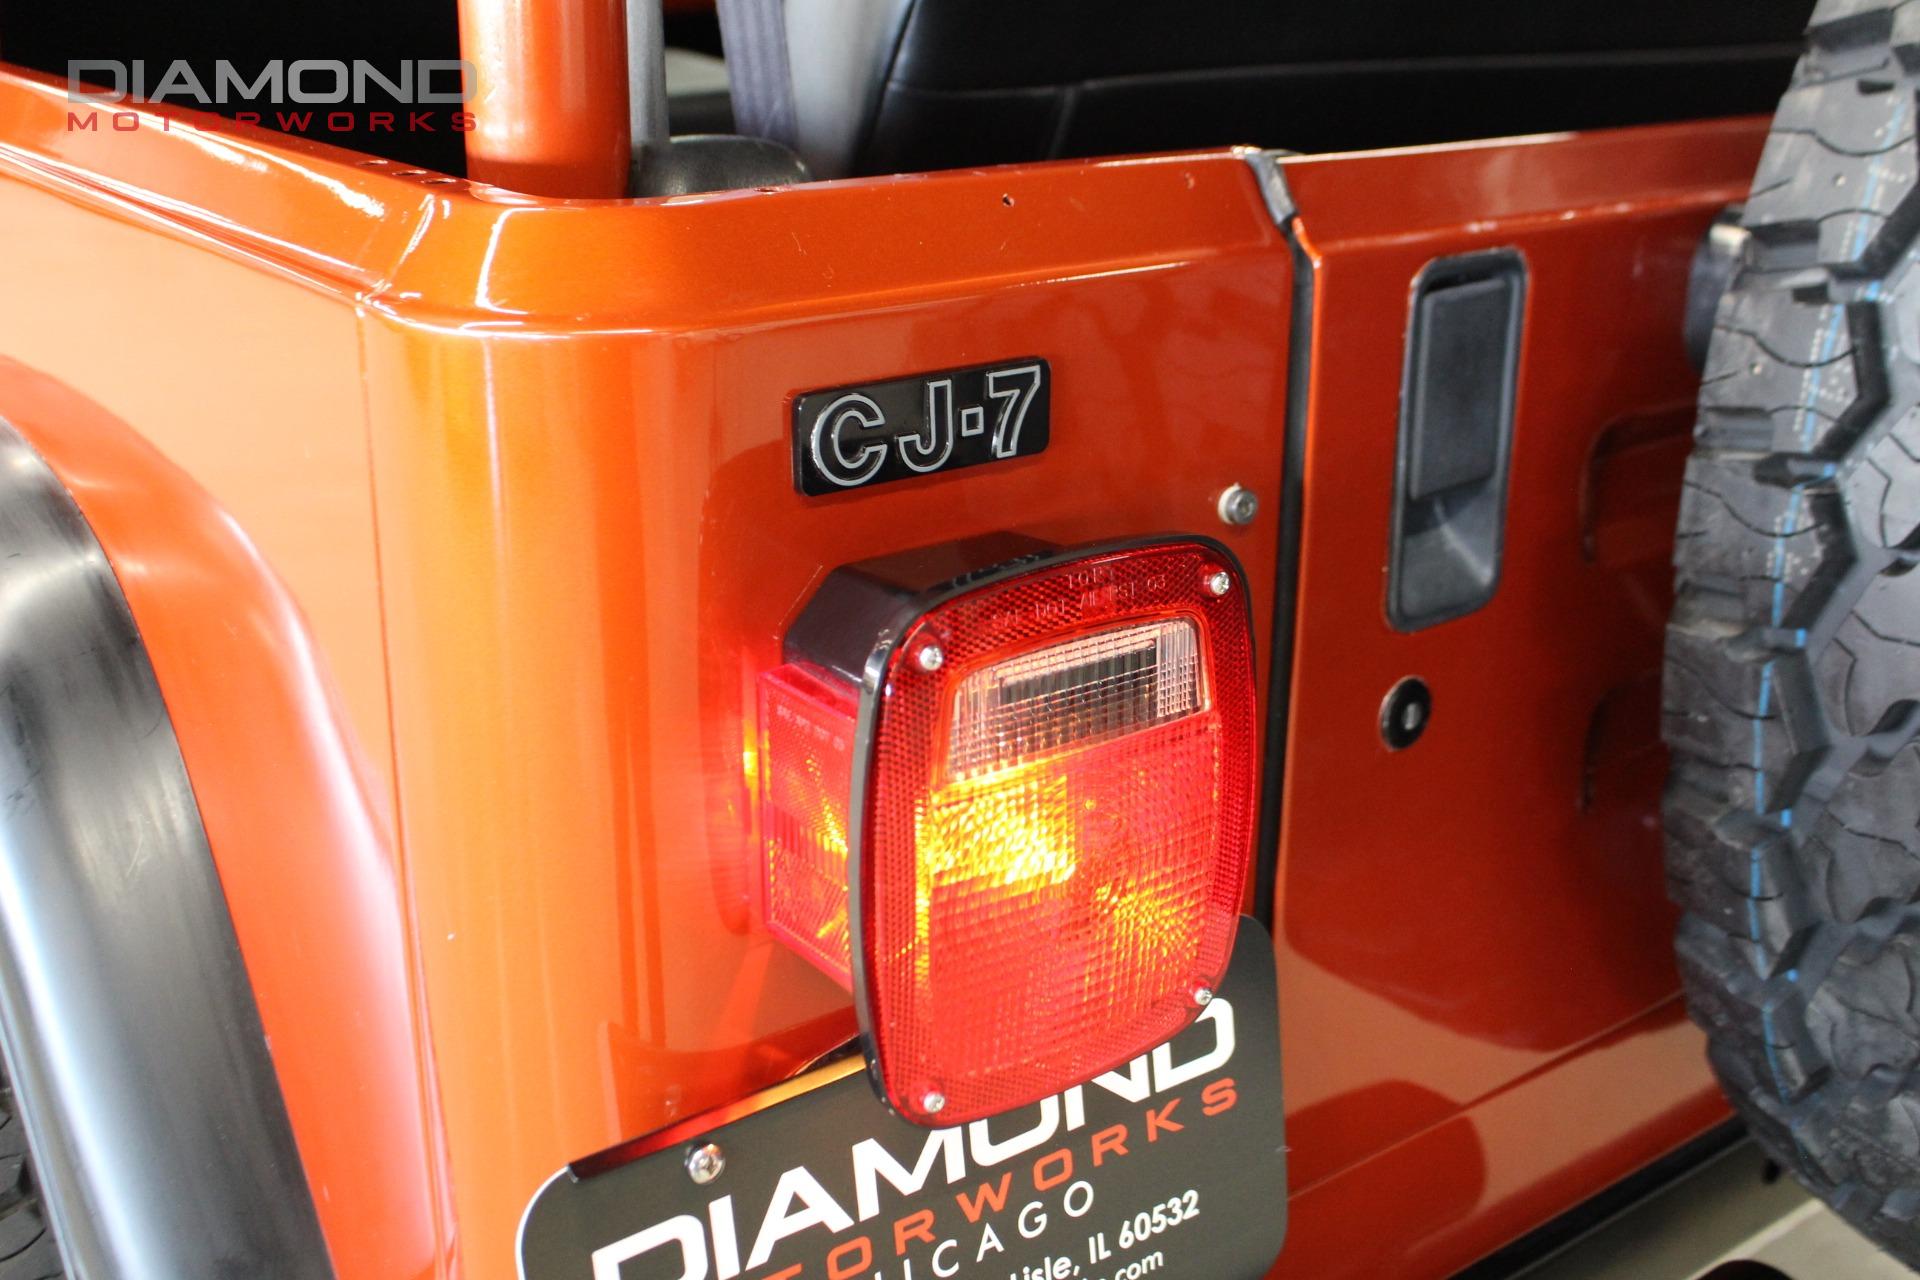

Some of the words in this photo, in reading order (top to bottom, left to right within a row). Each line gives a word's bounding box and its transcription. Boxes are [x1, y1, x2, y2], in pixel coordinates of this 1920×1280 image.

[811, 364, 1041, 487] CJ-7
[761, 1077, 1238, 1280] ORWORKS
[875, 1180, 1095, 1280] ICAGO
[1009, 1256, 1080, 1280] isle,
[1088, 1232, 1112, 1264] IL
[1118, 1189, 1201, 1249] 60532
